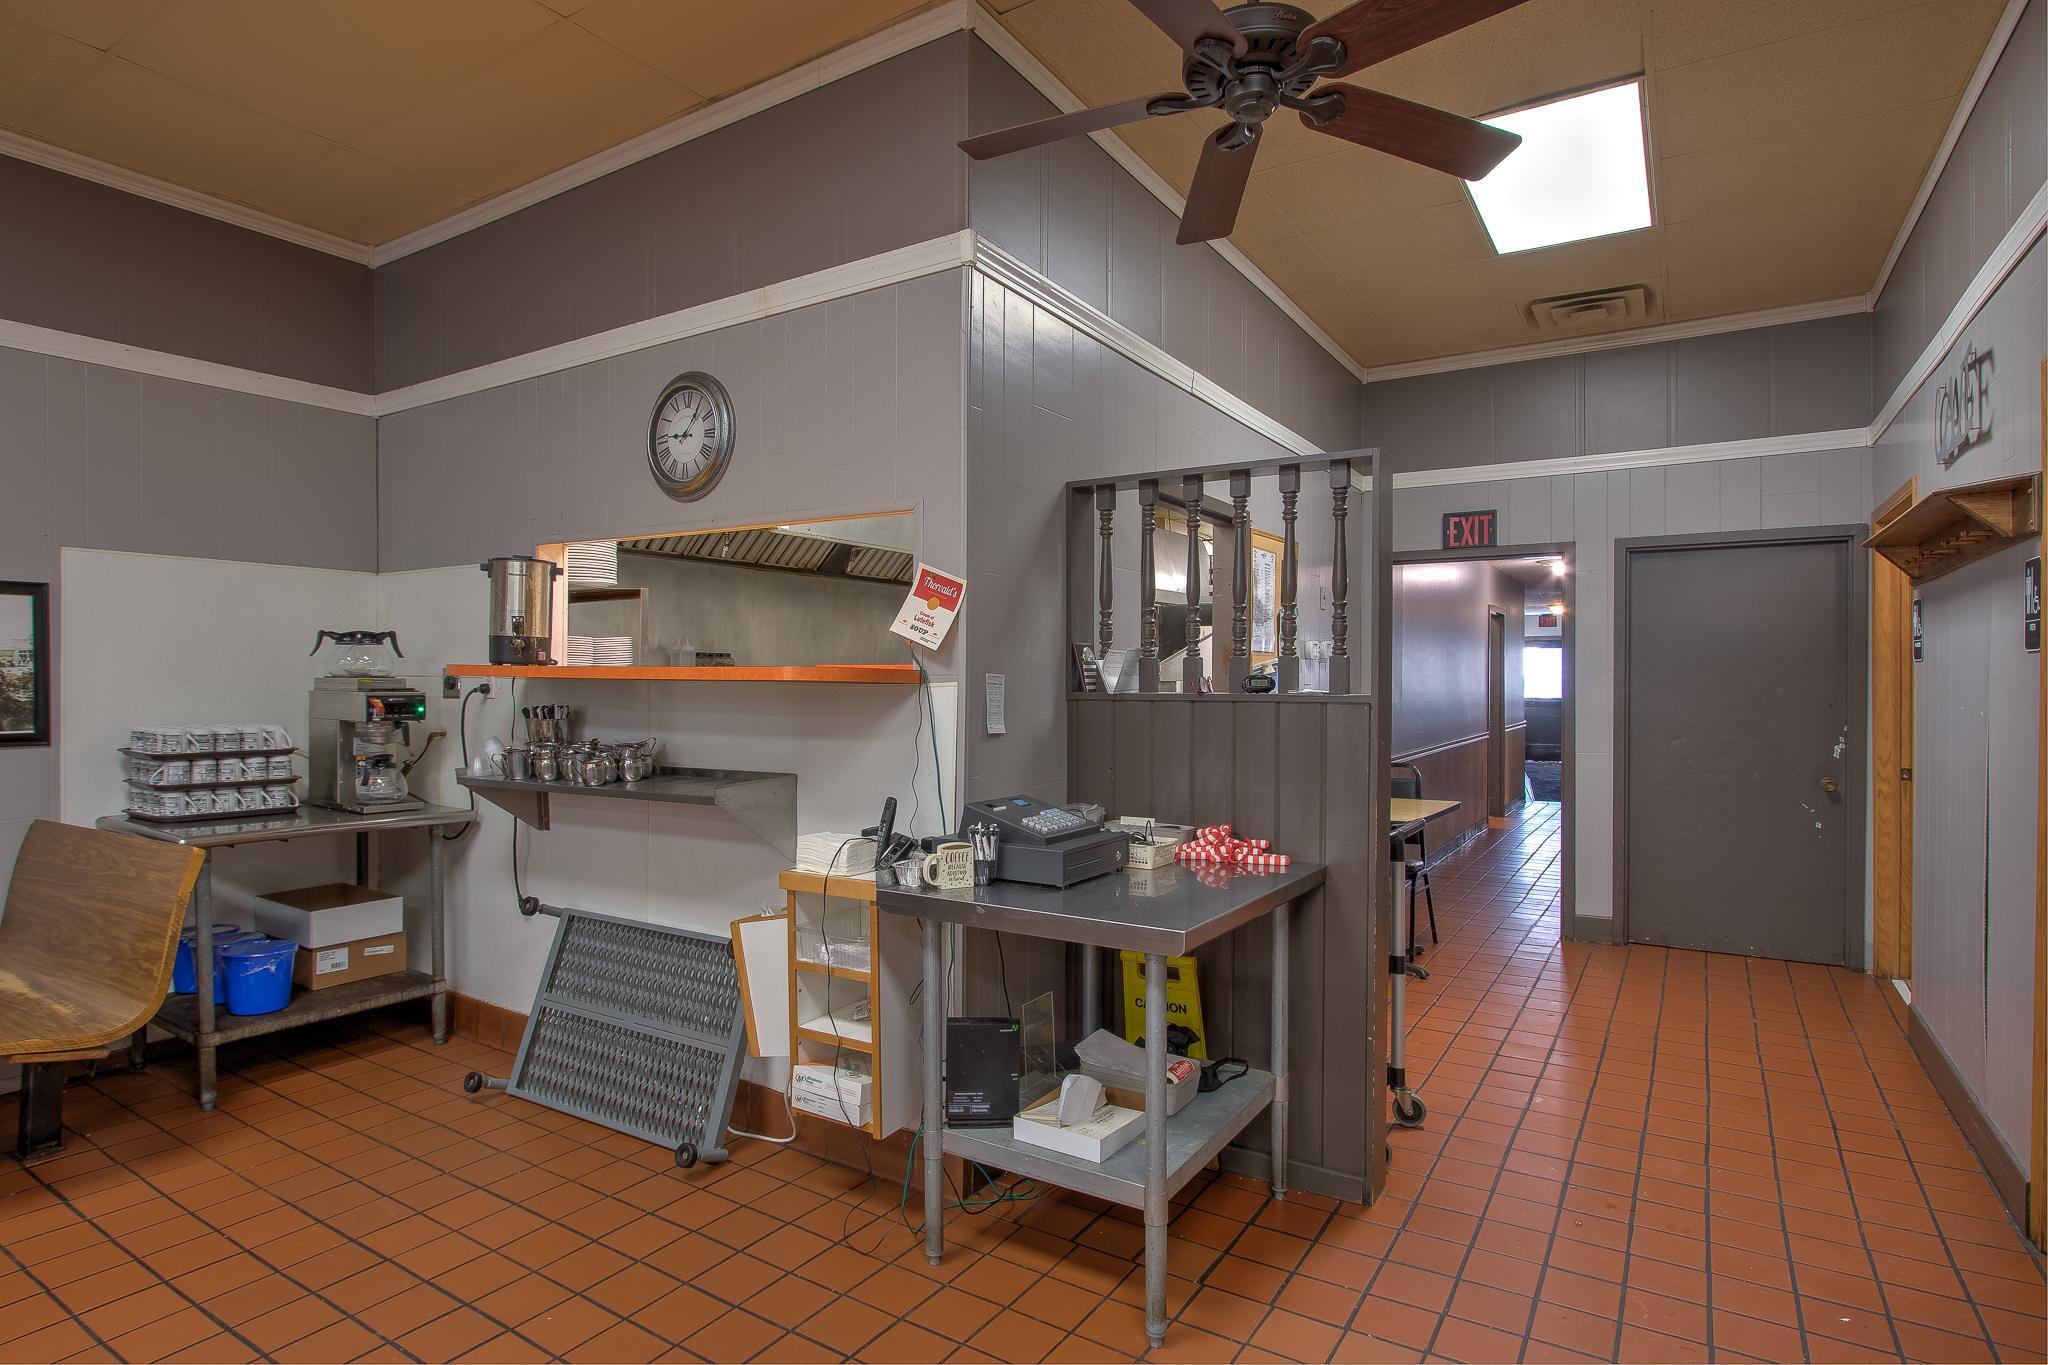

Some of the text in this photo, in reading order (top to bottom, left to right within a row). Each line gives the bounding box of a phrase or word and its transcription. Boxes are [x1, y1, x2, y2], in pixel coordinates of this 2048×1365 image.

[1449, 515, 1493, 547] EXIT
[924, 576, 958, 598] Thorvald's
[913, 614, 936, 629] Lutefisk
[909, 624, 929, 636] SOUP
[945, 851, 969, 865] COFFEE
